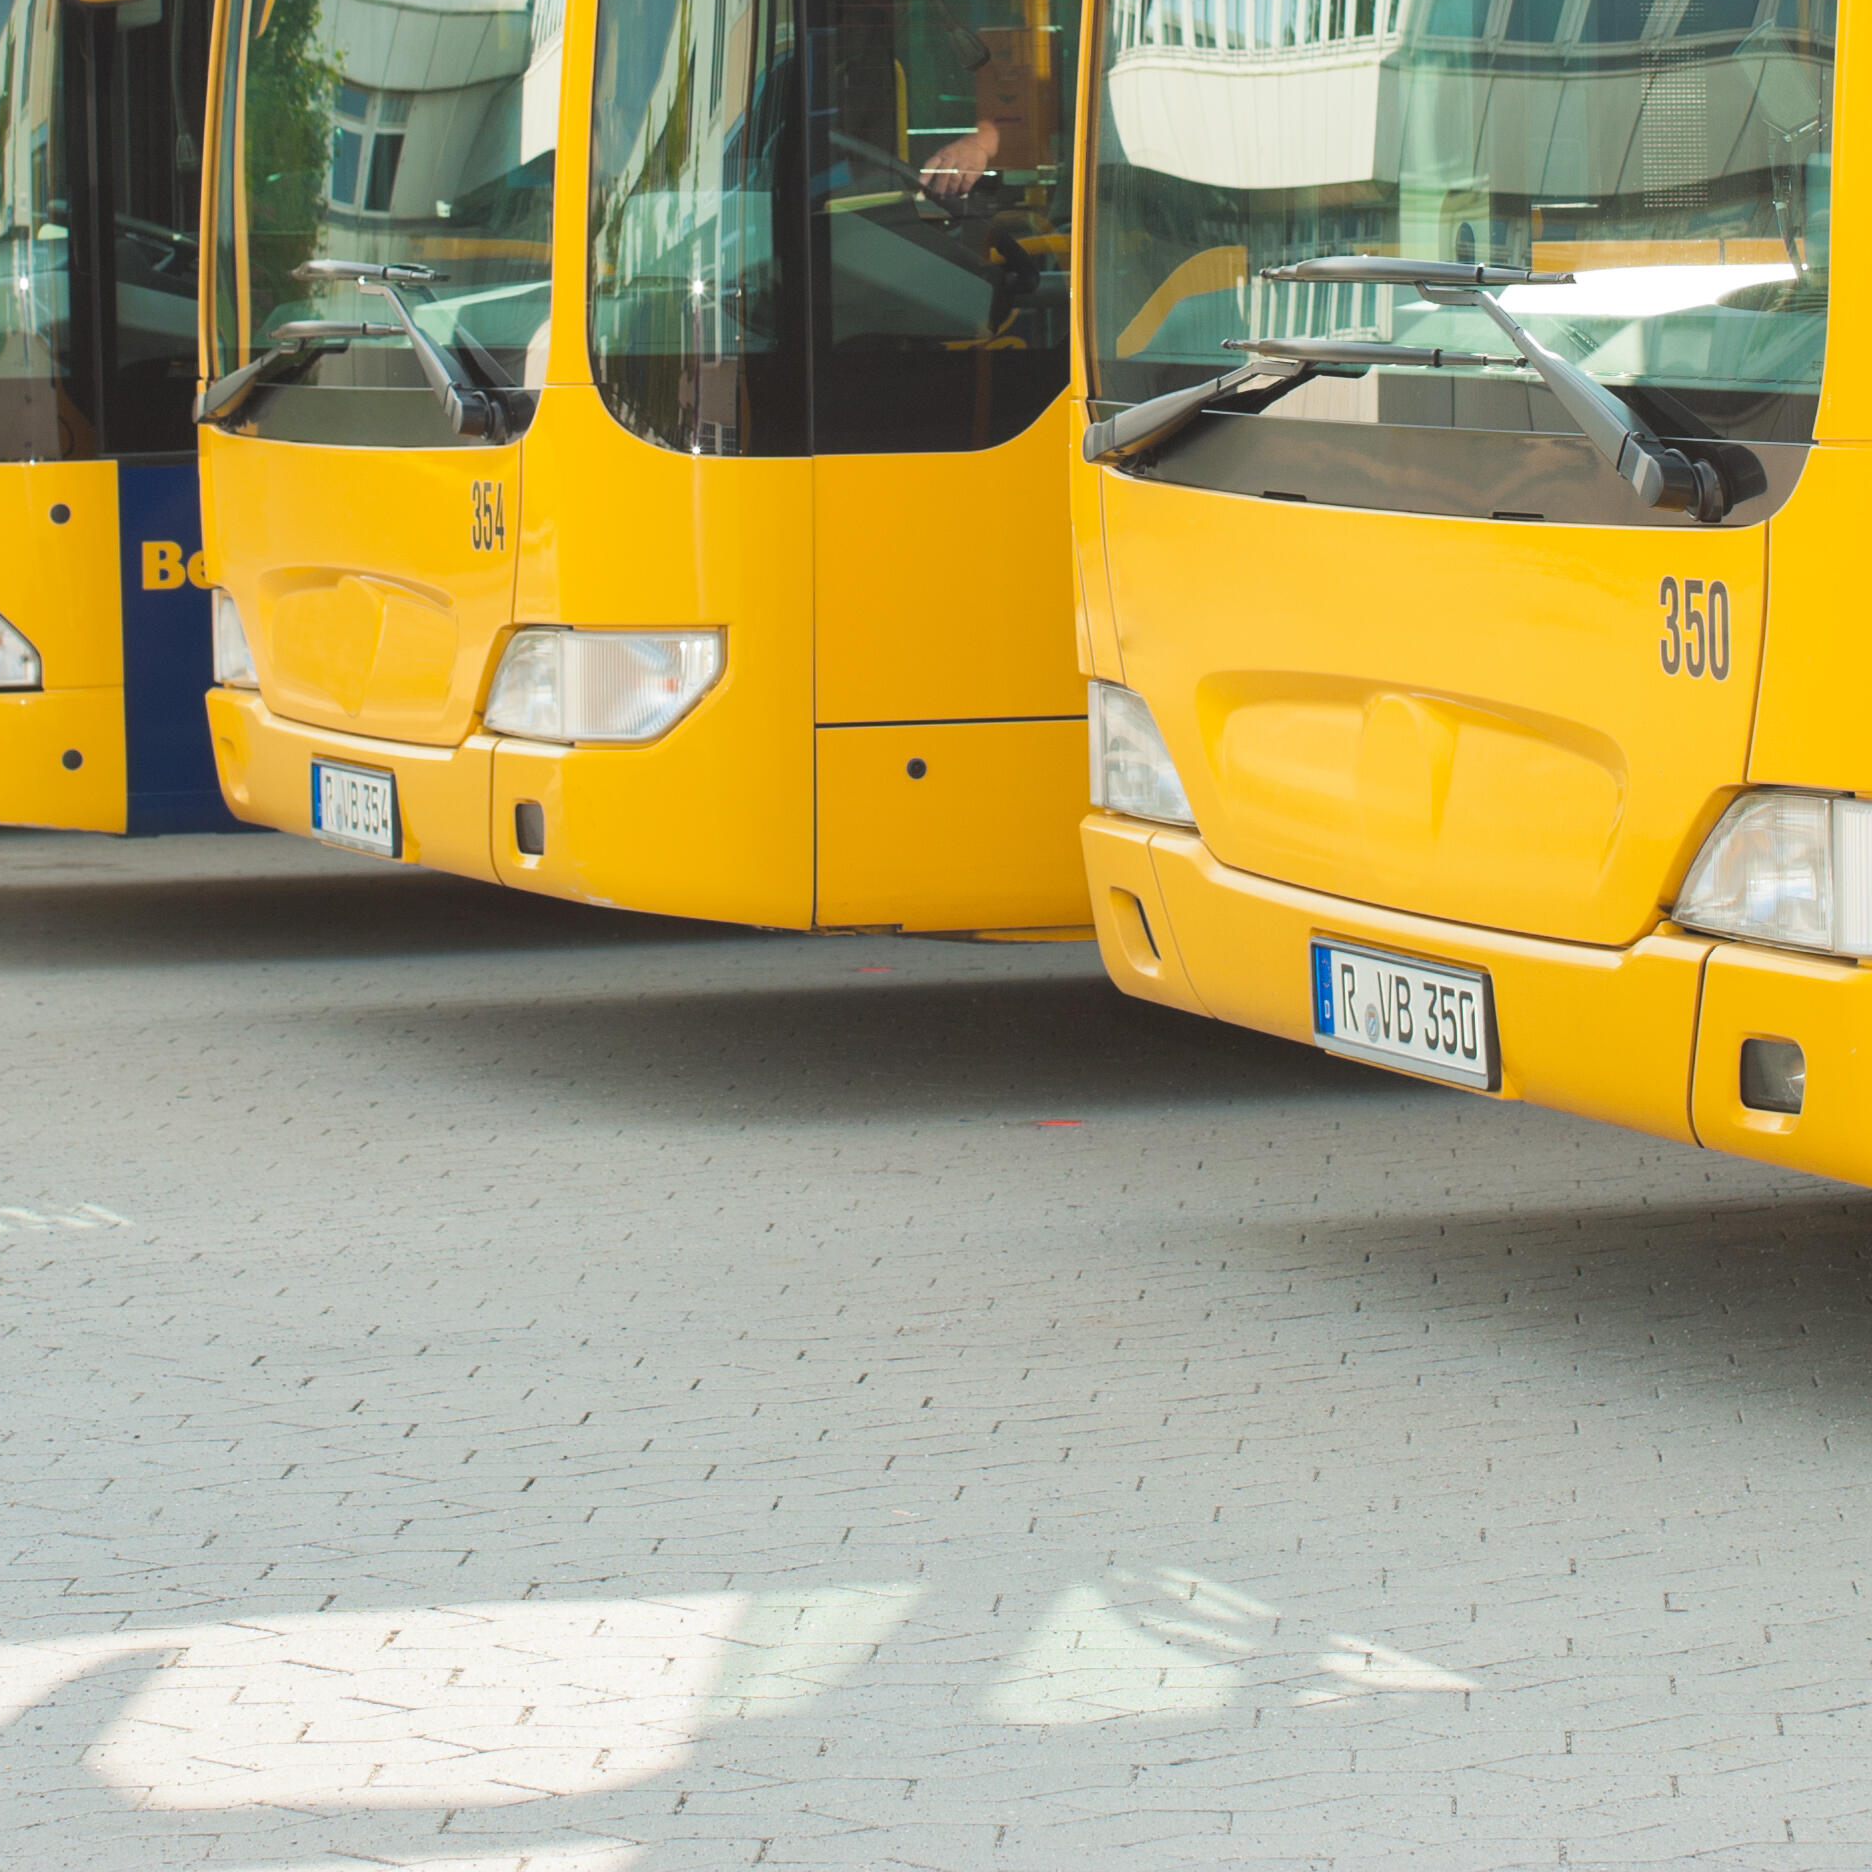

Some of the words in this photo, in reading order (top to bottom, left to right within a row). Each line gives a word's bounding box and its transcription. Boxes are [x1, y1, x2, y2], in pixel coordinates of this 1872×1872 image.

[472, 480, 504, 551] 354
[1659, 575, 1730, 681] 350
[326, 775, 334, 826] R
[342, 778, 359, 831] VB
[364, 783, 388, 839] 354
[1341, 963, 1359, 1032] R
[1377, 971, 1414, 1044] VB
[1423, 981, 1478, 1060] 350
